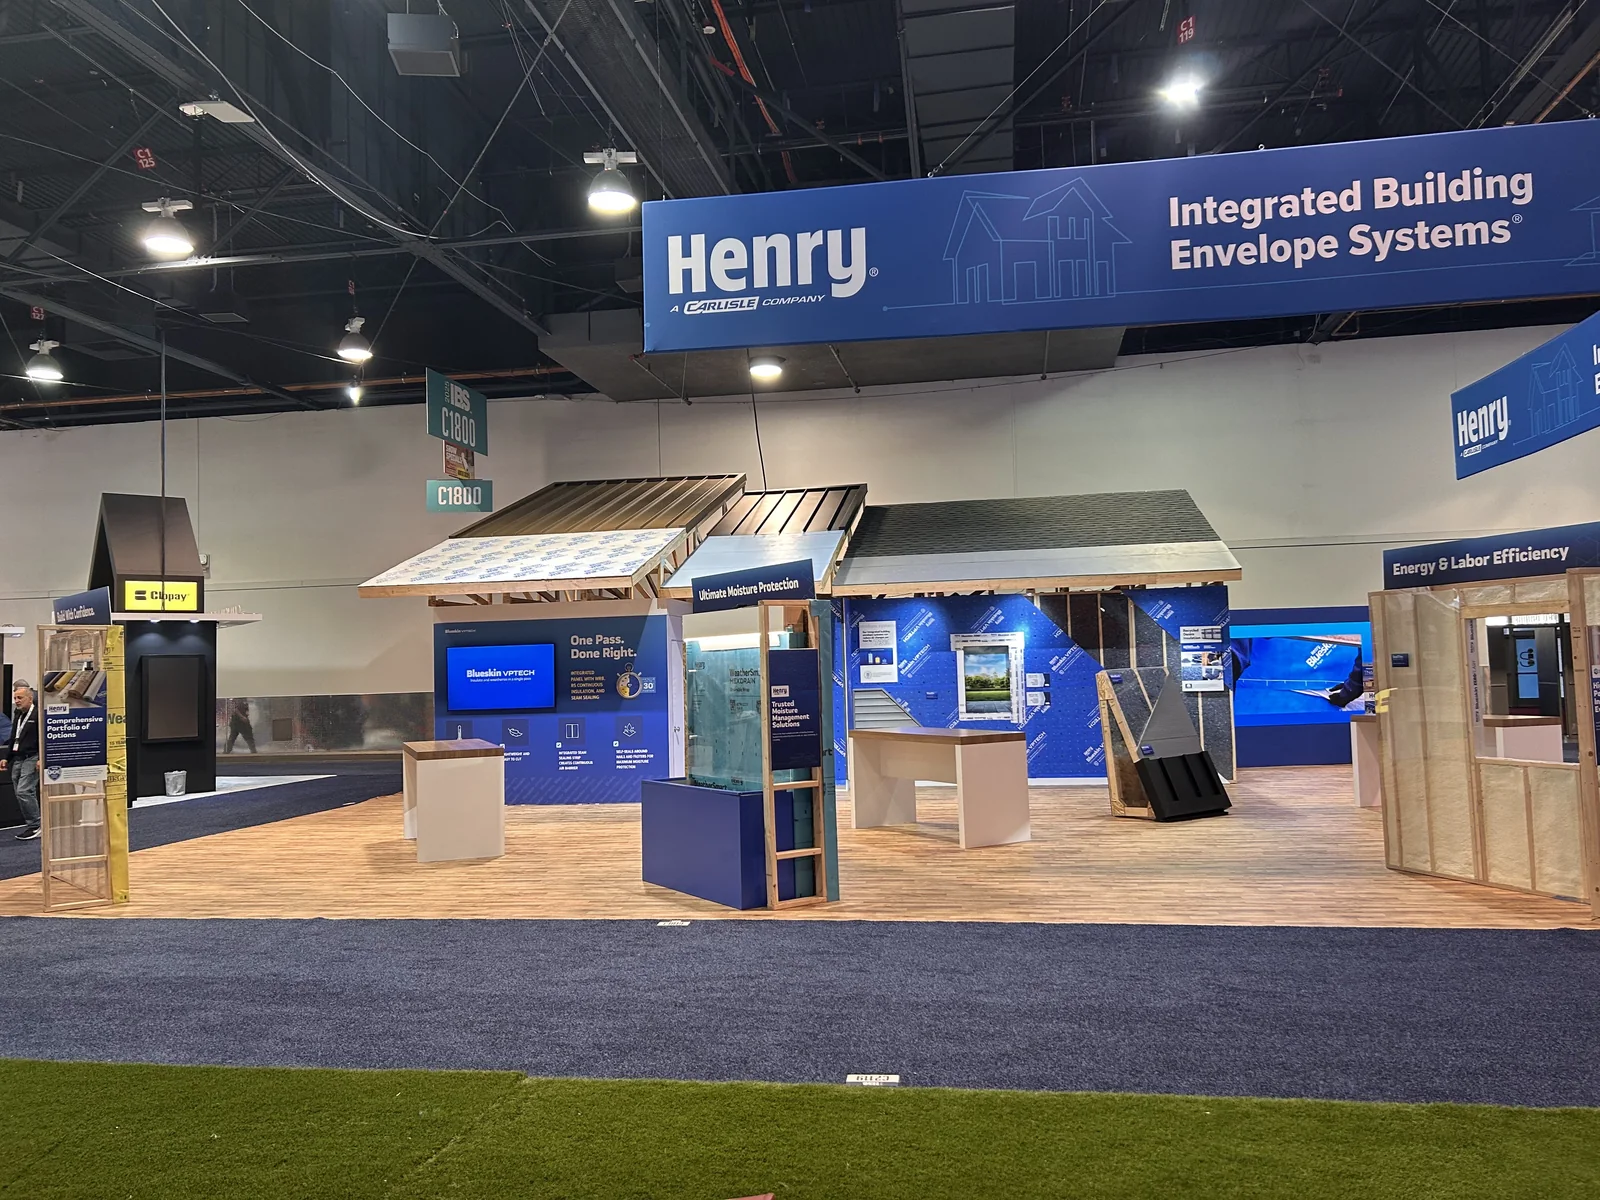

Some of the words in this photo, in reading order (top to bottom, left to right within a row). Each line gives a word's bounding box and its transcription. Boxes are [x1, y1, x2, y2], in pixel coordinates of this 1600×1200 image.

[1181, 16, 1193, 31] C1
[1180, 28, 1194, 43] 119
[137, 148, 151, 158] C1
[139, 158, 156, 168] 125
[1169, 180, 1362, 229] Integrated
[1373, 167, 1533, 206] Building
[1170, 233, 1340, 270] Envelope
[670, 305, 679, 313] A
[685, 297, 757, 313] CARLISLE
[762, 295, 826, 306] COMPANY
[450, 383, 471, 412] IBS
[442, 407, 476, 448] C1800
[438, 486, 482, 506] C1800
[1393, 562, 1436, 576] Energy
[1438, 557, 1448, 571] &
[1451, 553, 1490, 569] Labor
[1492, 546, 1570, 565] Efficiency
[698, 588, 727, 601] Ultimate
[727, 584, 758, 597] Moisture
[758, 577, 799, 593] Protection
[150, 590, 188, 602] Clopay
[570, 635, 593, 646] One
[595, 634, 625, 645] Pass.
[570, 648, 600, 659] Done
[602, 646, 637, 660] Right.
[466, 668, 502, 678] Blueskin
[502, 669, 535, 677] VPTECH
[772, 700, 795, 708] Trusted
[47, 716, 104, 725] Comprehensive
[772, 714, 810, 723] Management
[772, 721, 800, 729] Solutions
[47, 723, 81, 732] Portfolio
[47, 732, 76, 740] Options
